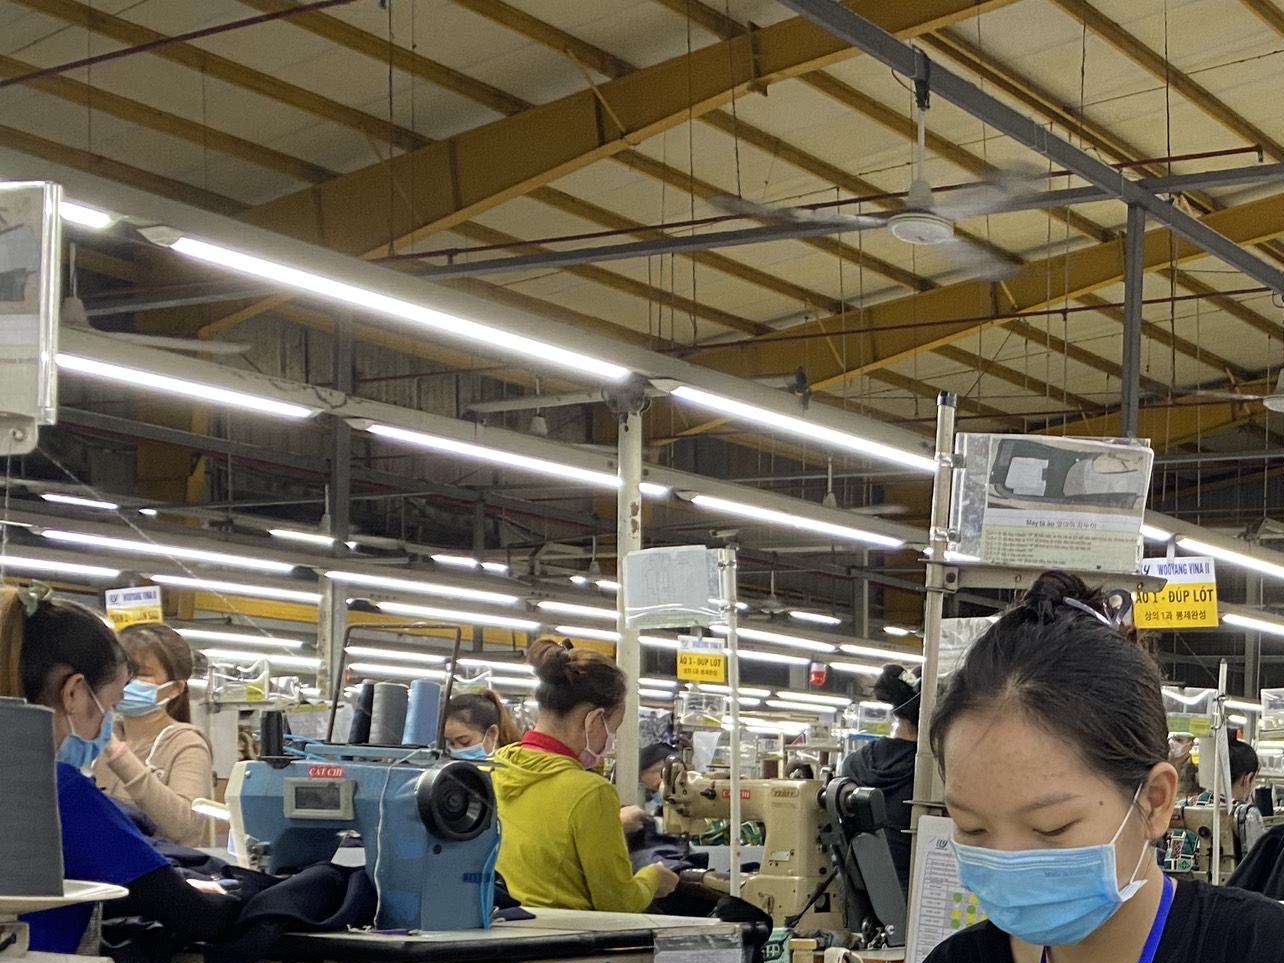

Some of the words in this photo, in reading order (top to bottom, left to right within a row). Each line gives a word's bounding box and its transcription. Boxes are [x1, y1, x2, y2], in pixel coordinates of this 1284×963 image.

[1026, 519, 1038, 527] May
[1158, 563, 1187, 575] WOOYANG
[1189, 563, 1203, 575] VINA
[1169, 587, 1190, 603] ĐÚP
[1194, 586, 1213, 602] LÓT
[1145, 611, 1158, 621] 상의
[1176, 610, 1206, 620] 봉제완성
